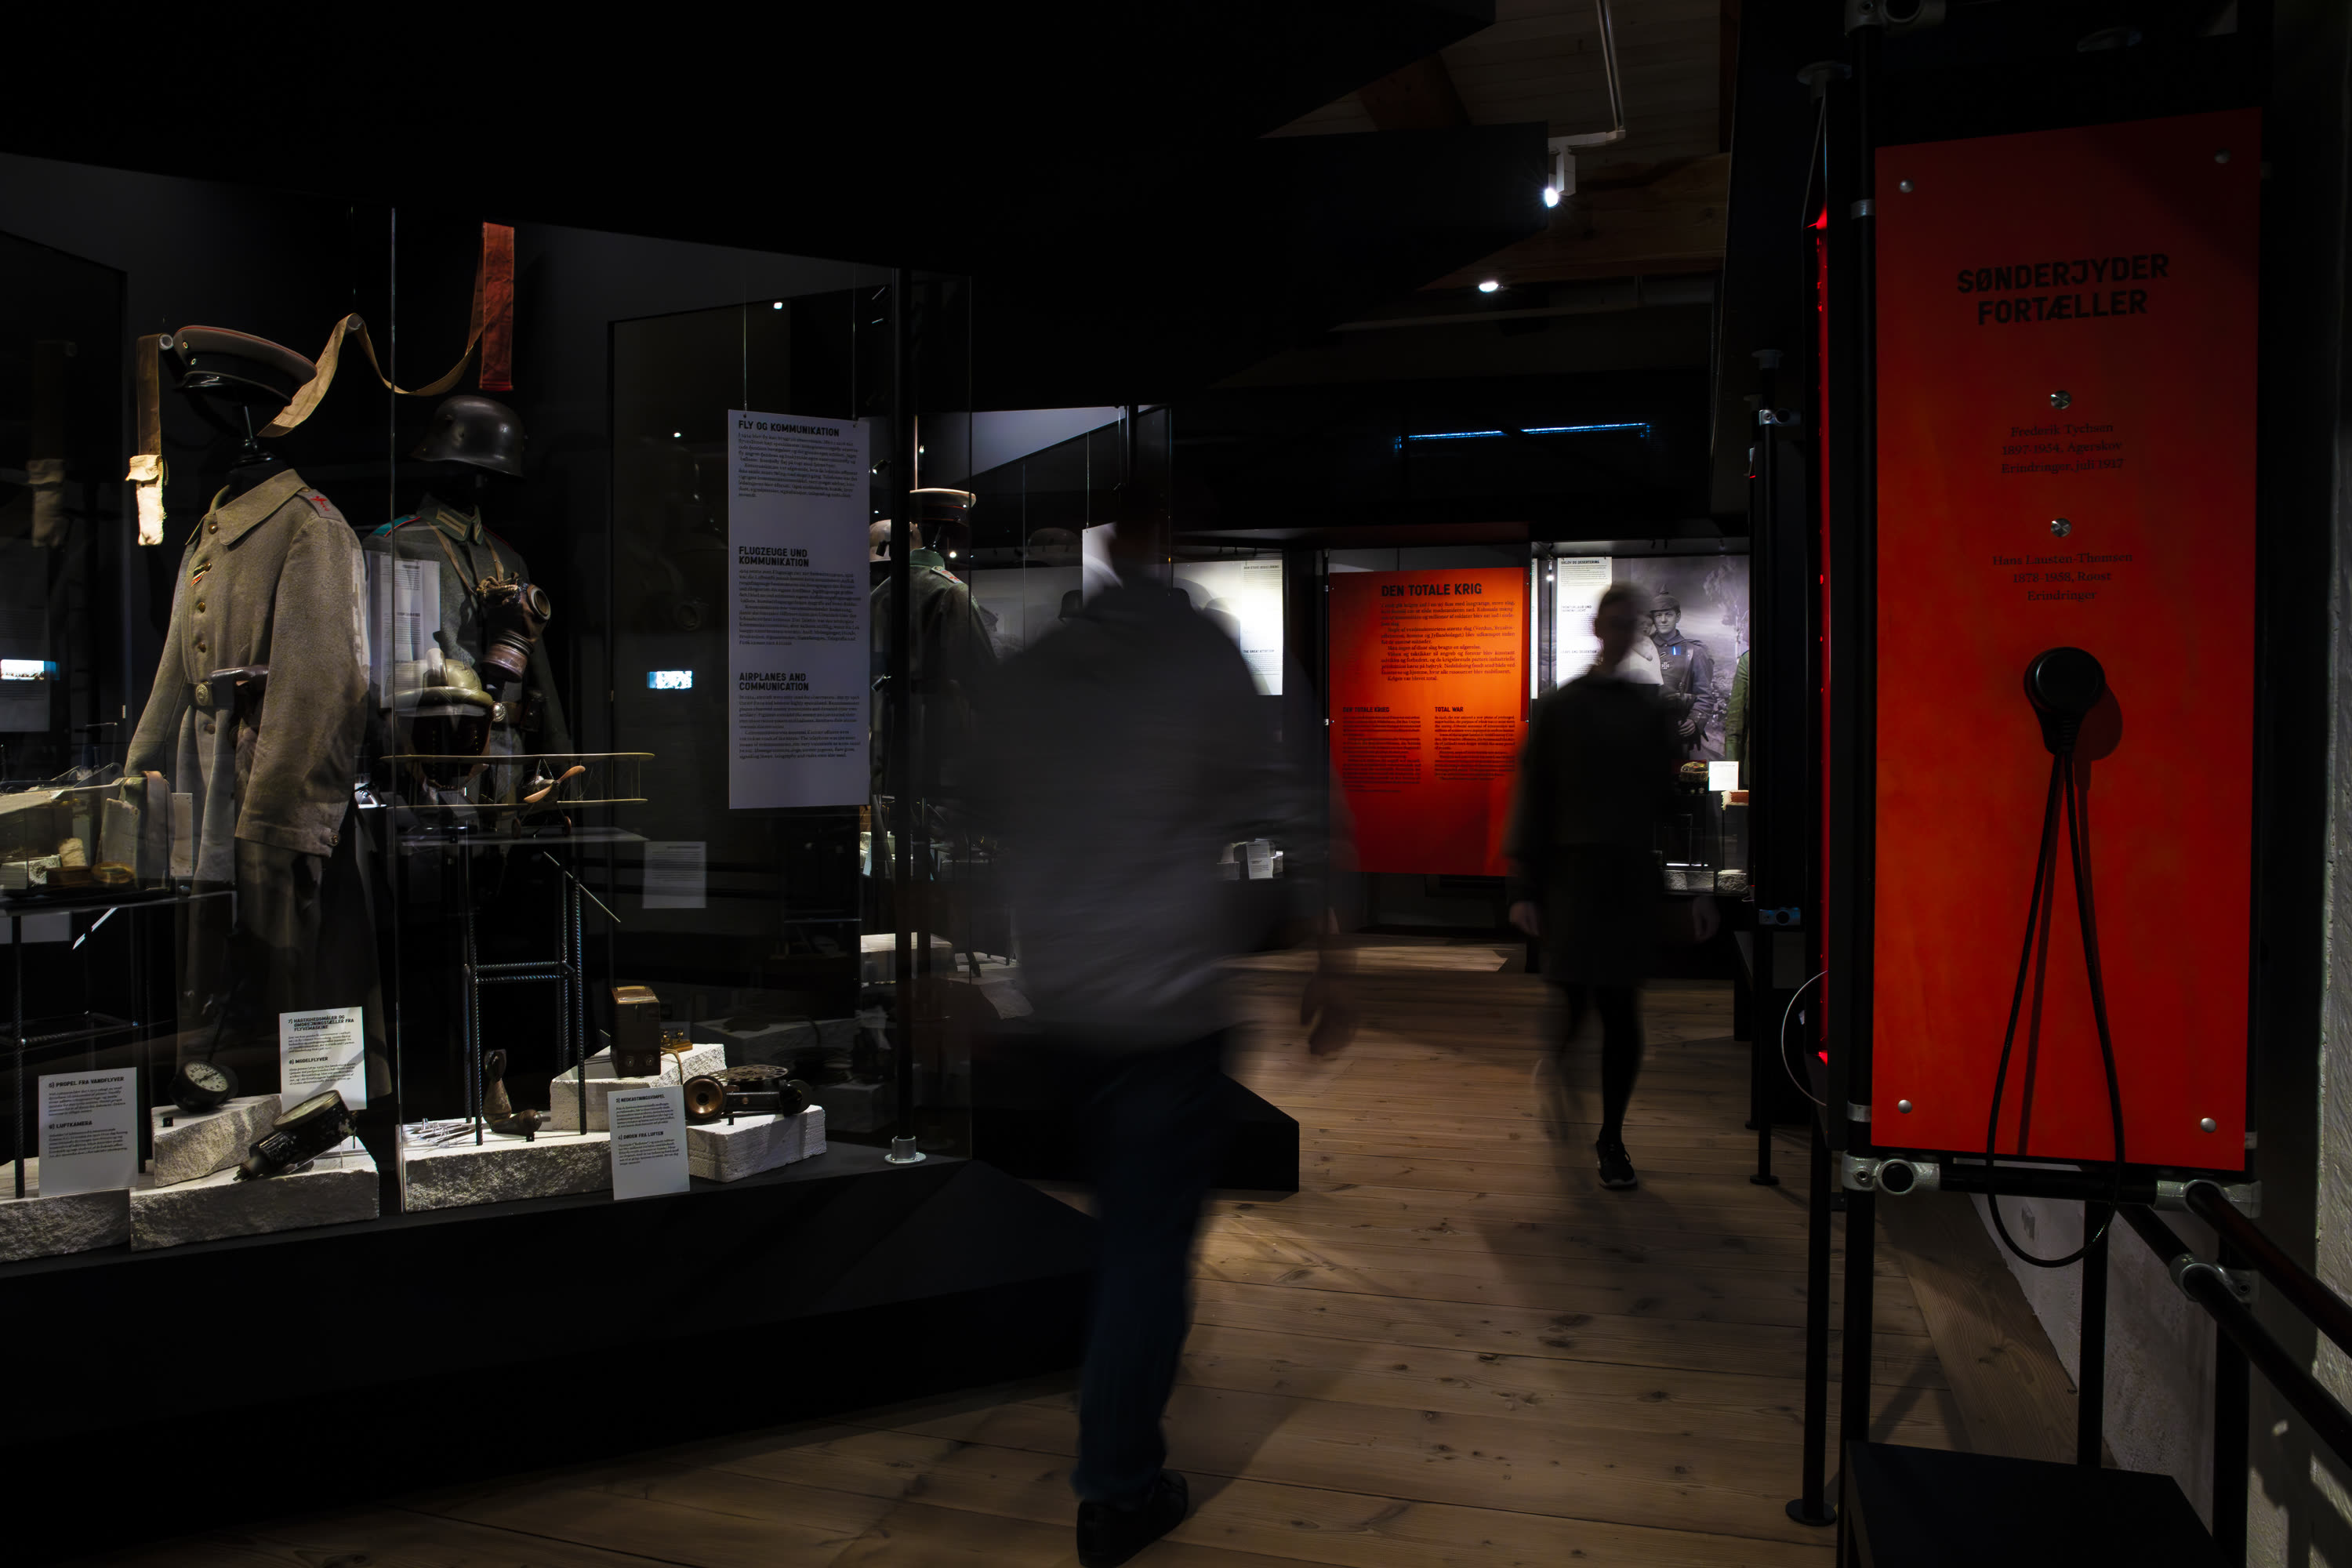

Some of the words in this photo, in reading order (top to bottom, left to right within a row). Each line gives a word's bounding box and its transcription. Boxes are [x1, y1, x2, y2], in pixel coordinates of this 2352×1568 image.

[1958, 253, 2170, 293] SØNDERJYDER
[1978, 289, 2149, 325] FORTÆLLER
[739, 420, 753, 430] FLY
[757, 422, 768, 430] OG
[771, 423, 840, 437] KOMMUNIKATION
[2010, 424, 2060, 437] Frederik
[2063, 423, 2114, 436] Tychsen
[2067, 441, 2123, 454] Agerskov
[2074, 459, 2094, 473] juli
[2098, 459, 2125, 469] 1917
[739, 546, 788, 557] FLUGZEUGE
[790, 549, 808, 557] UND
[739, 556, 809, 567] KOMMUNIKATION
[1992, 555, 2023, 565] Hans
[2026, 553, 2132, 565] Lausten-Thomsen
[2013, 572, 2074, 583] 1878-1958,
[1381, 585, 1404, 596] DEN
[1408, 584, 1450, 596] TOTALE
[1454, 583, 1482, 595] KRIG
[2027, 590, 2097, 603] Erindringer
[739, 673, 786, 681] AIRPLANES
[789, 673, 806, 681] AND
[739, 682, 809, 691] COMMUNICATION
[56, 1120, 93, 1129] LUFTKAMERA
